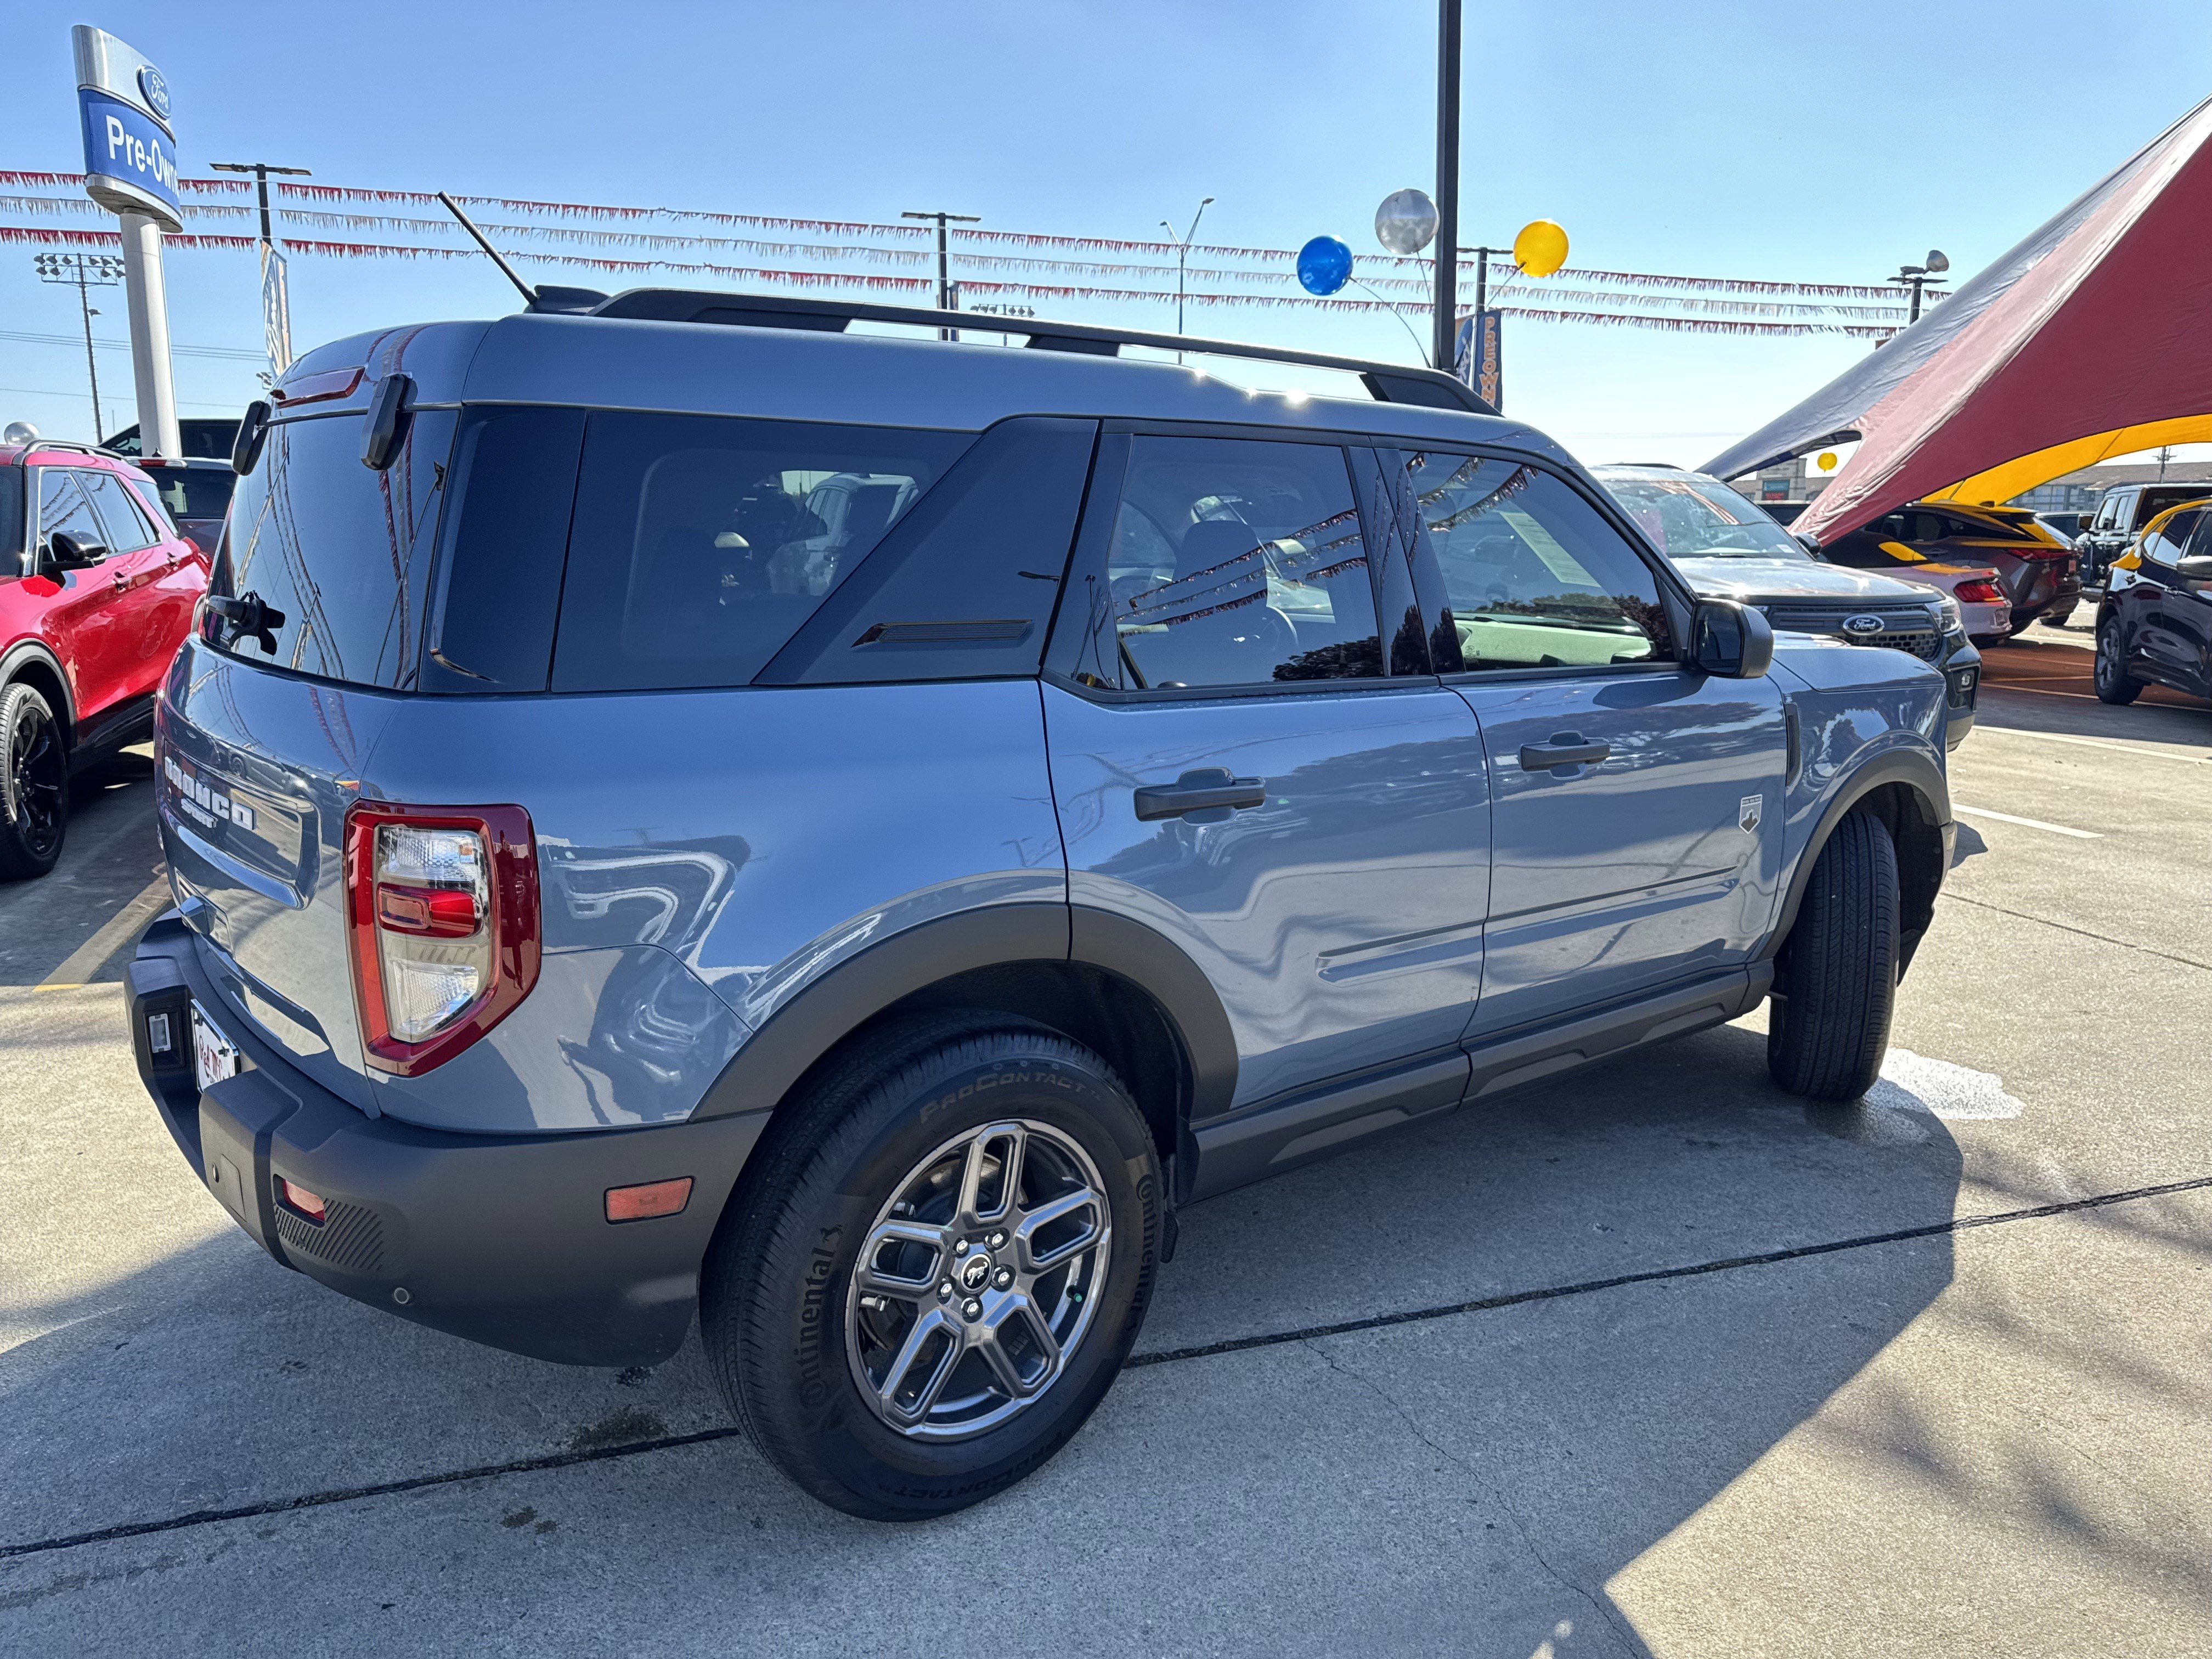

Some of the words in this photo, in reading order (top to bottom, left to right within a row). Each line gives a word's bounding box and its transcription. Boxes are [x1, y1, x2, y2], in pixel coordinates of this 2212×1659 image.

[151, 74, 170, 110] Ford
[1854, 619, 1876, 630] Ford
[165, 756, 255, 830] BRONCO
[794, 1245, 836, 1408] Continental
